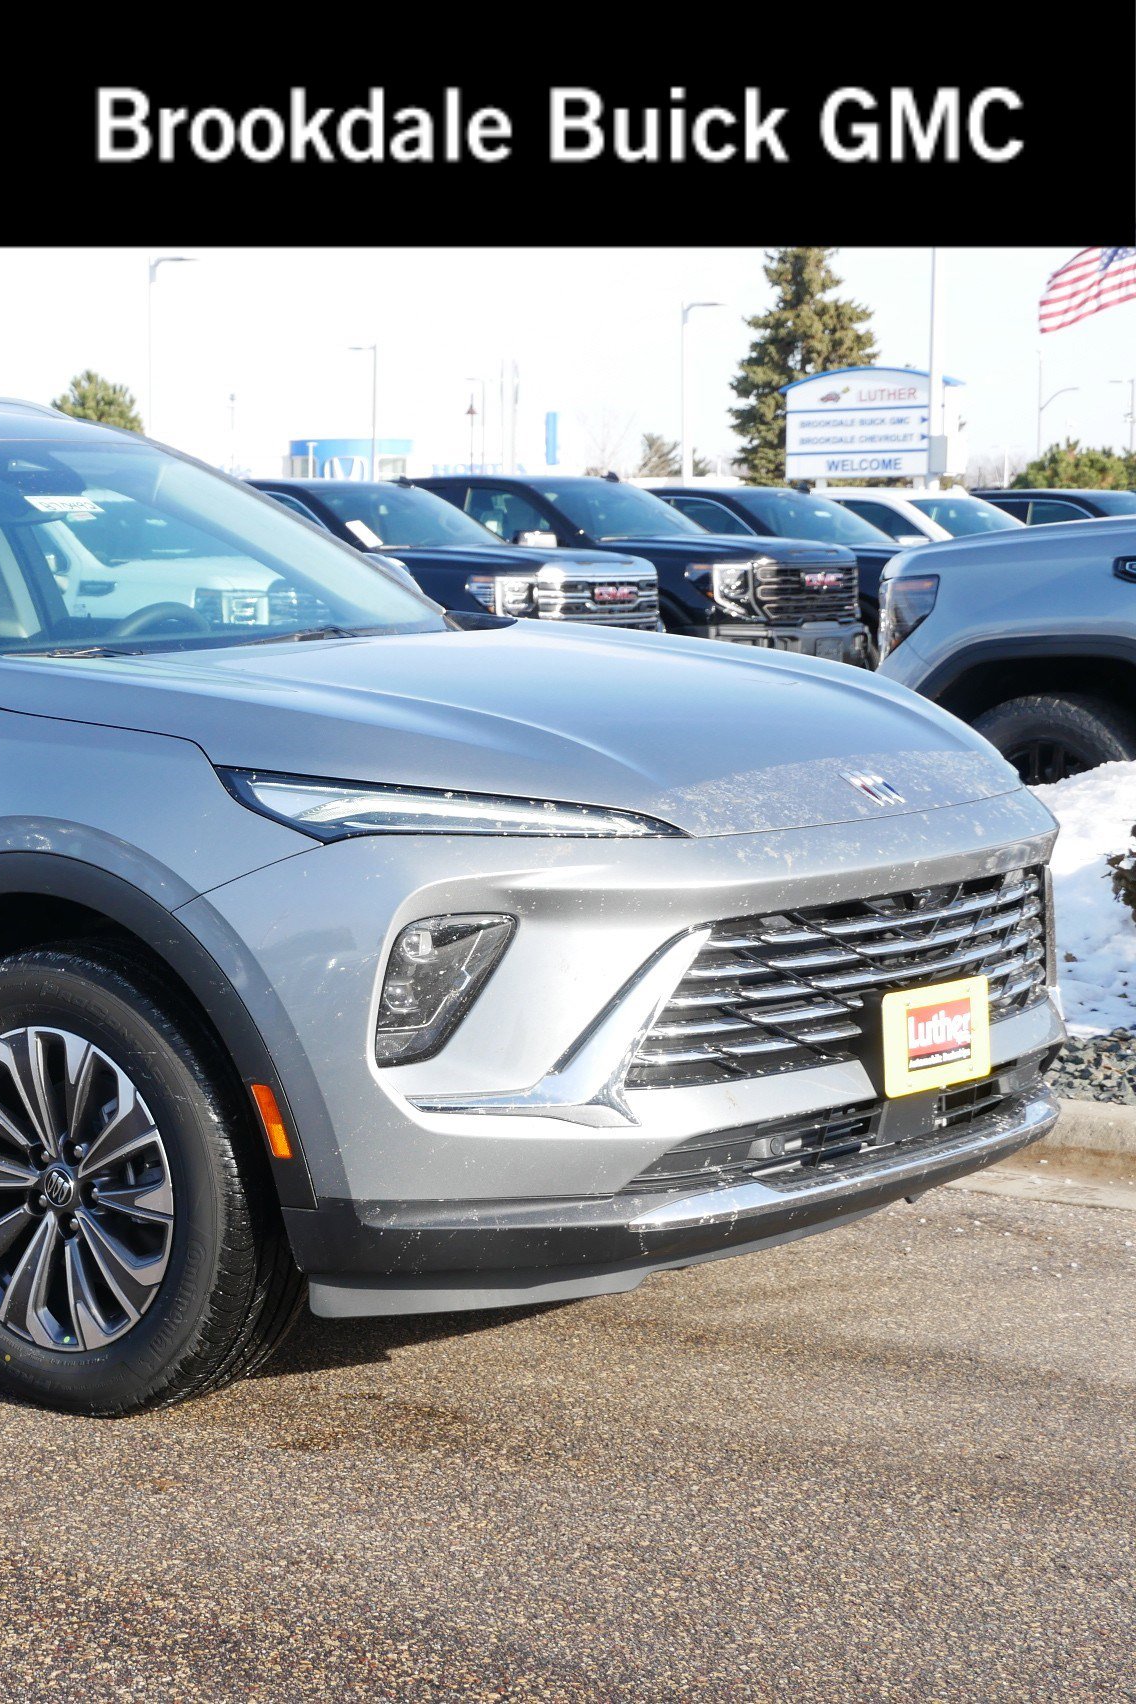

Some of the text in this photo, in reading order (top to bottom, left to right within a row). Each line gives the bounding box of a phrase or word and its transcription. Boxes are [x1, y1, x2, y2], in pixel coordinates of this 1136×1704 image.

[859, 387, 918, 402] LUTHER
[799, 415, 911, 429] BROOKDALE BUICK GMC
[799, 433, 914, 446] BROOKDALE CHEVROLET
[826, 457, 902, 472] WELCOME
[907, 1009, 971, 1049] Luther
